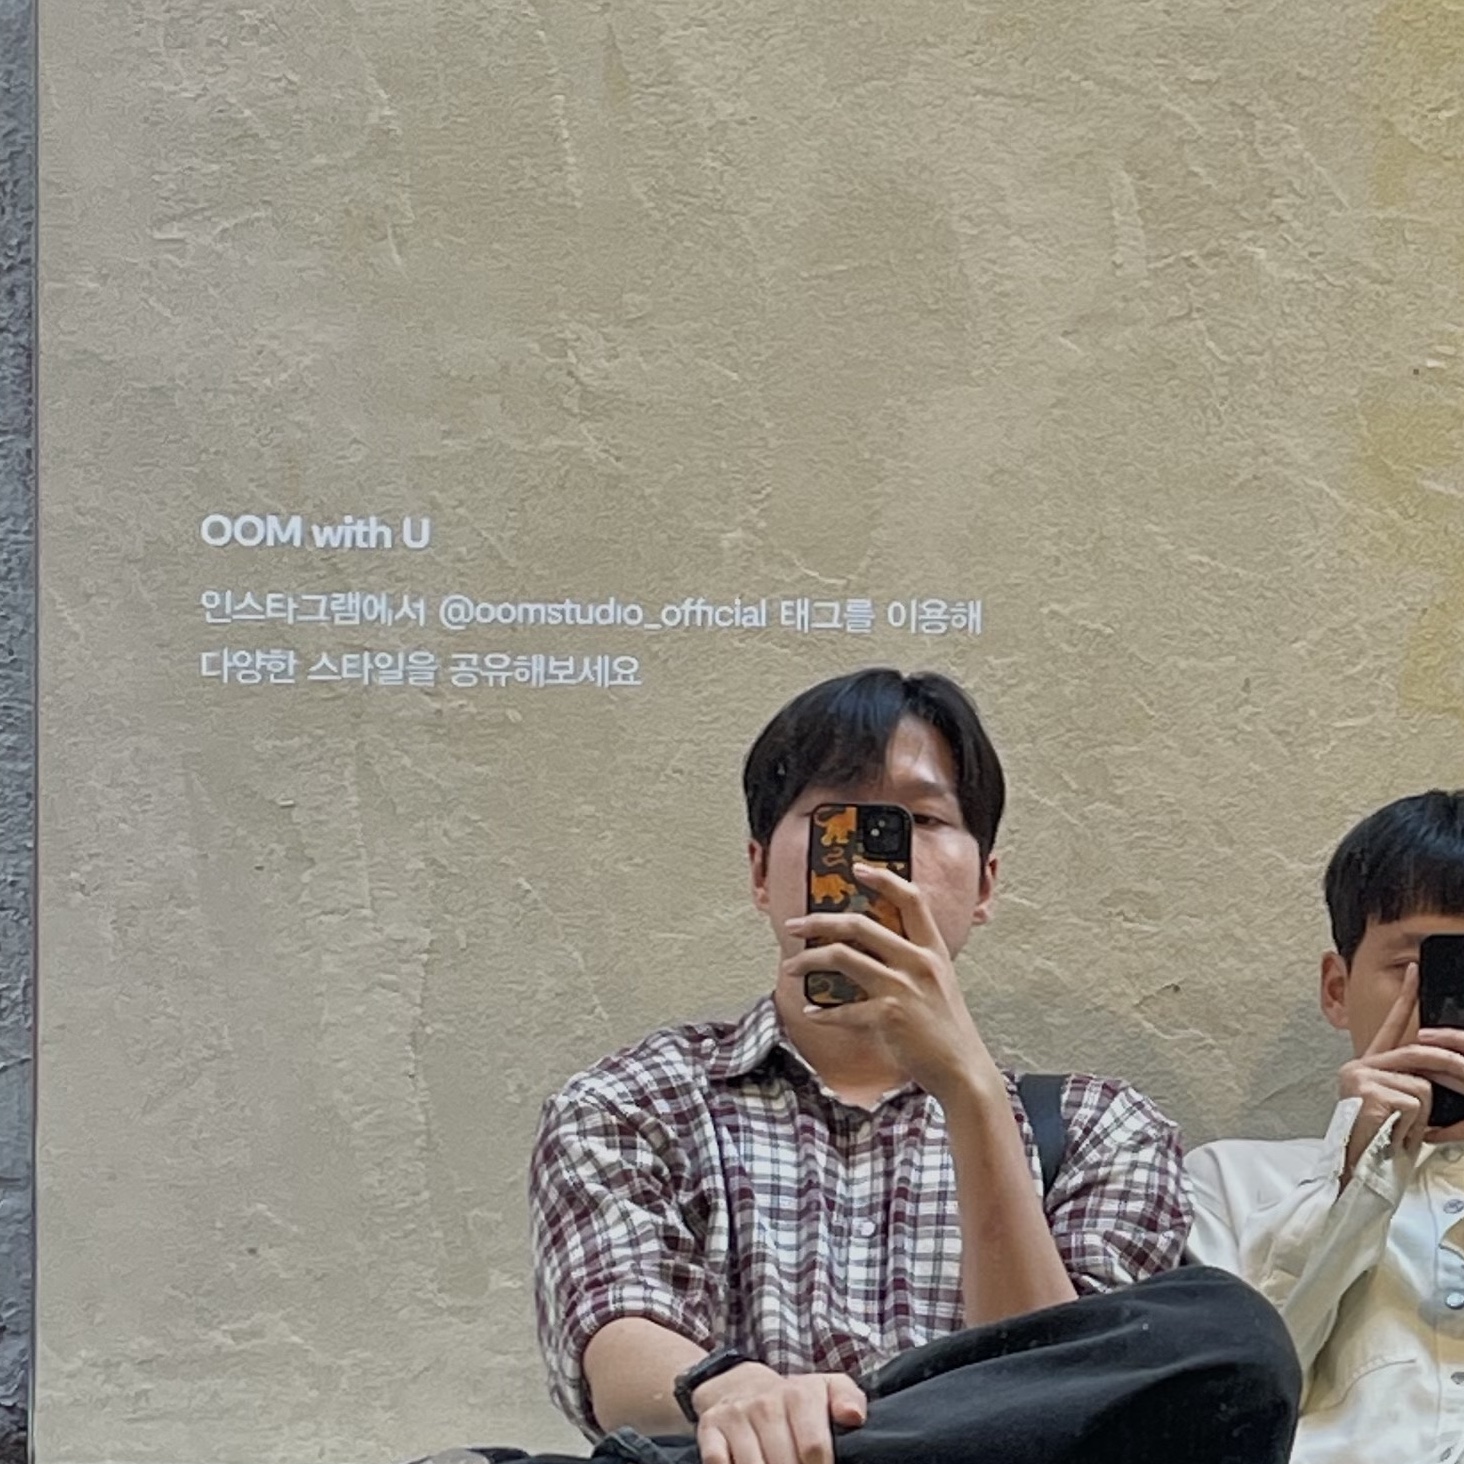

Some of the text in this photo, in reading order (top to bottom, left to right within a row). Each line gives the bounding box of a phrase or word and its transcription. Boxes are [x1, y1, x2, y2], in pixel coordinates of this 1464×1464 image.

[201, 514, 431, 549] OOM with U
[201, 590, 983, 635] 인스타그램에서 @oomstudio_official 태그를 이용해
[200, 647, 642, 689] 다양한 스타일을 공유해보세요
